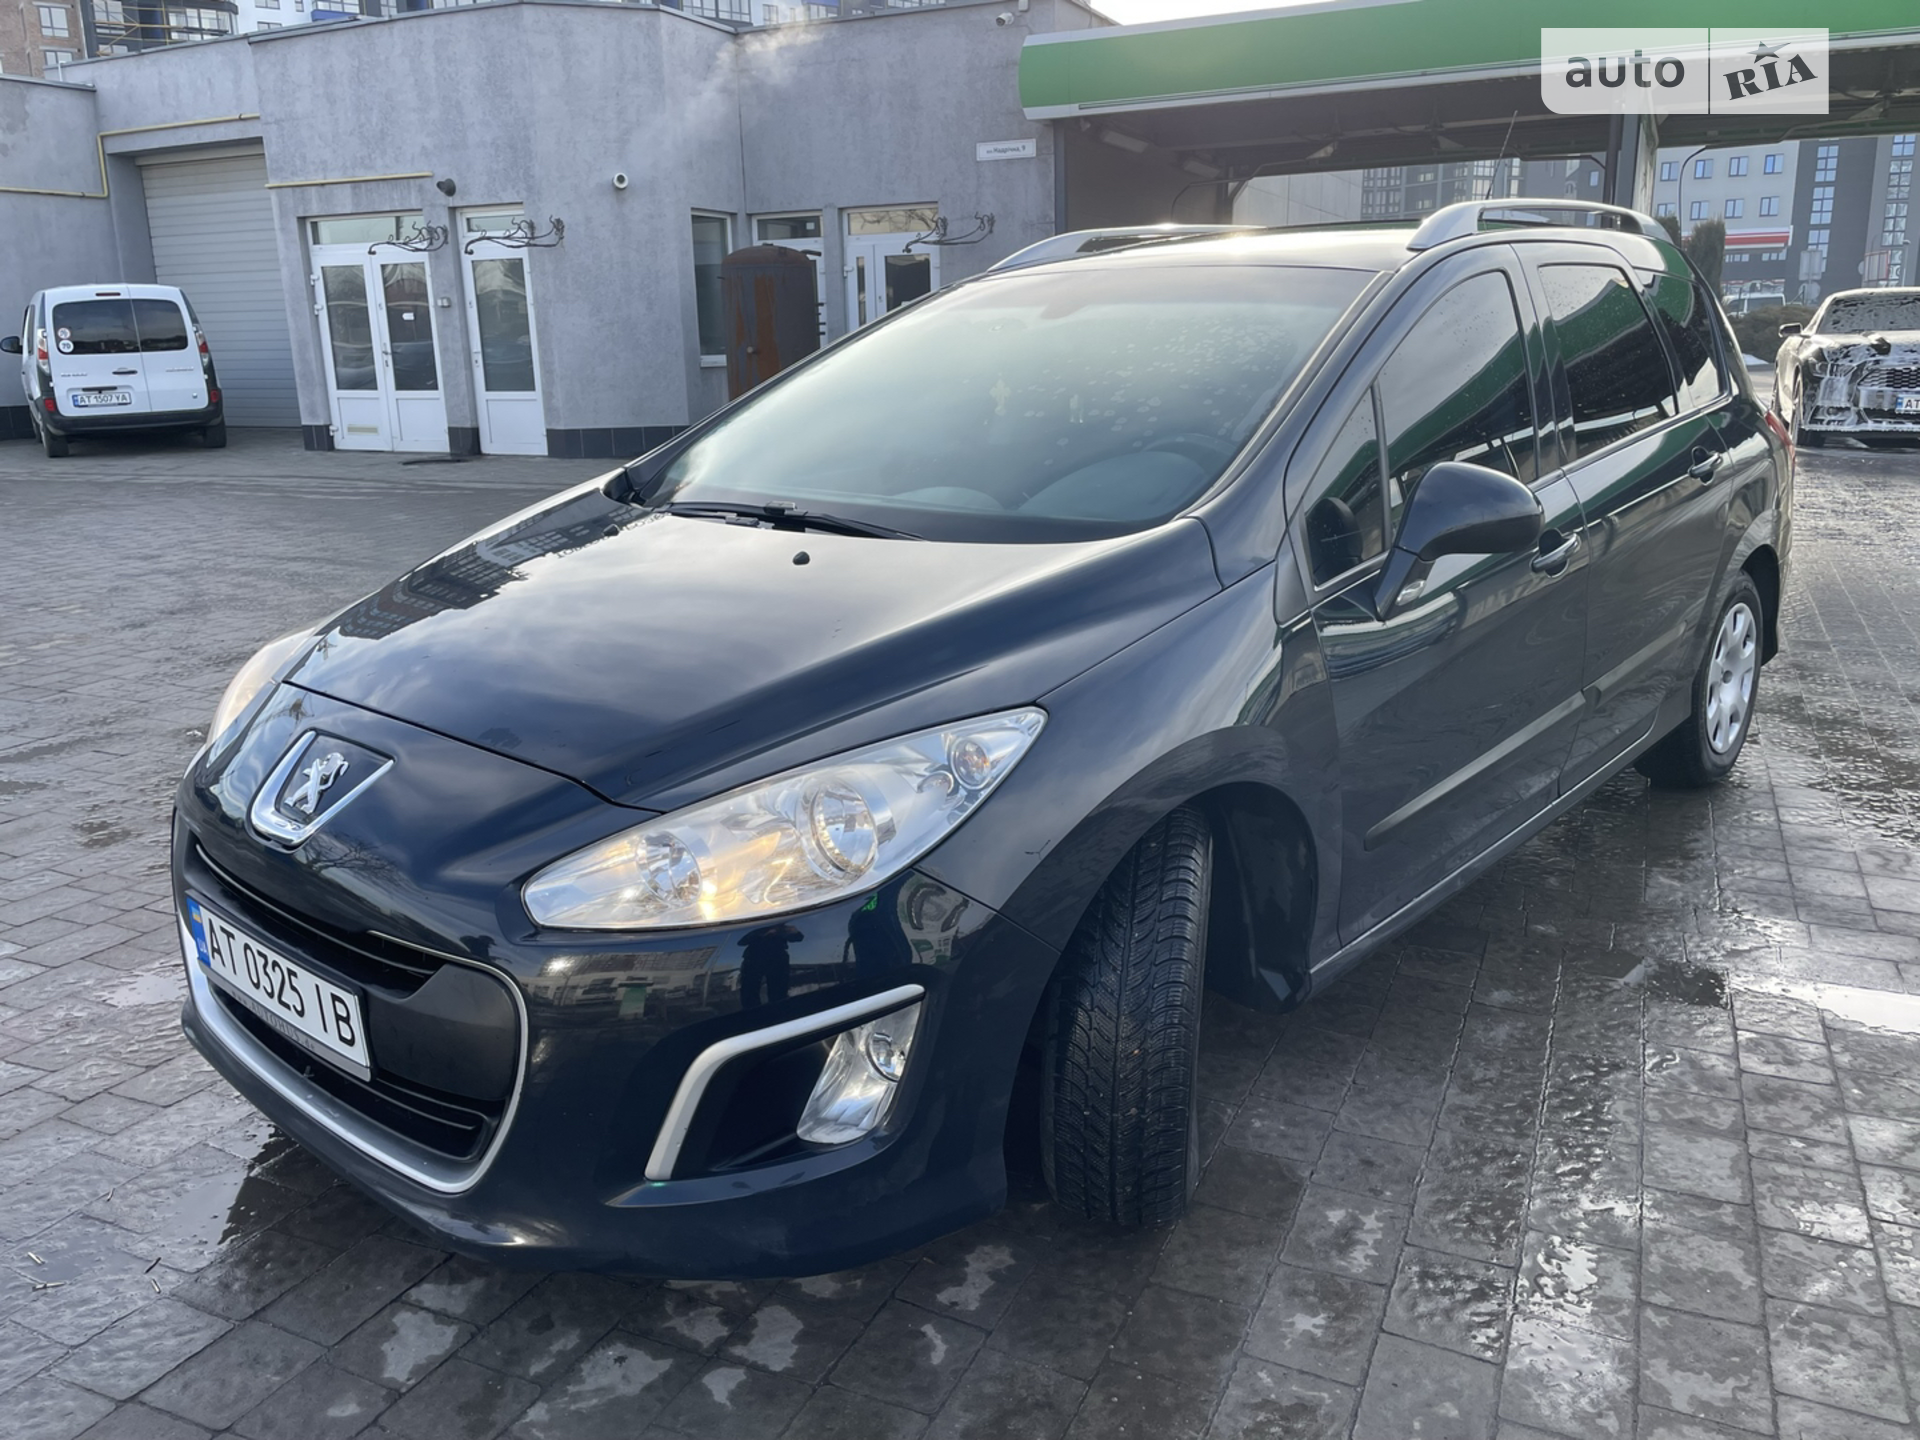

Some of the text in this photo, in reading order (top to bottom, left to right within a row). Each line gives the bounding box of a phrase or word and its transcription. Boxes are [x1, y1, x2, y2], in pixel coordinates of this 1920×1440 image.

[79, 395, 91, 404] AT
[93, 394, 113, 404] 1507
[114, 393, 128, 403] YA
[1905, 399, 1920, 408] AT
[208, 917, 356, 1048] AT 0325 IB
